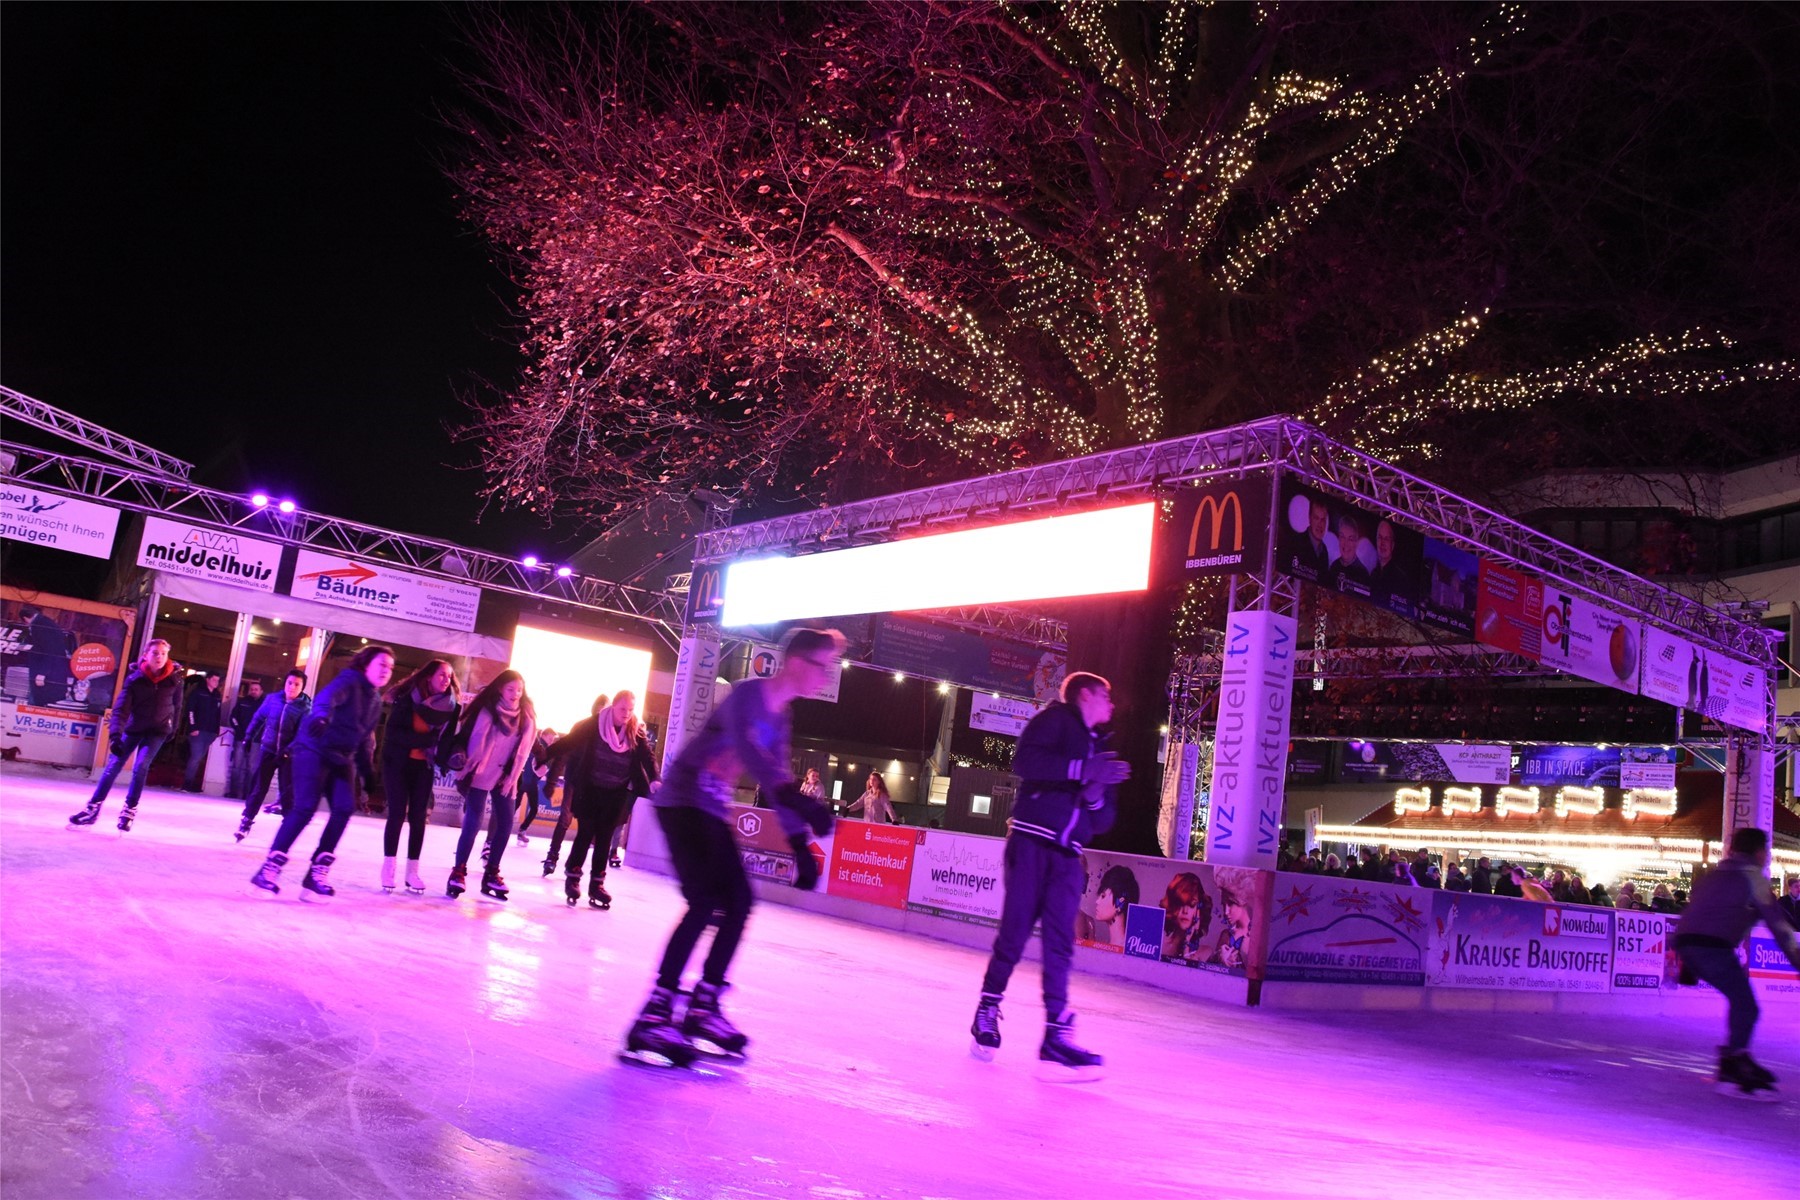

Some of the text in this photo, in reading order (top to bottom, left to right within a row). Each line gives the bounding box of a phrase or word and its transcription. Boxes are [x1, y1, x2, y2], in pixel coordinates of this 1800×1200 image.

[17, 513, 68, 532] wünscht
[72, 524, 105, 540] Ihnen
[183, 528, 239, 555] AVM
[146, 542, 272, 581] middelhuis
[1185, 554, 1242, 569] IBBENBÜREN
[317, 574, 400, 605] Bäumer
[893, 623, 905, 633] sind
[15, 715, 68, 731] VR-Bank
[1525, 759, 1541, 774] IBB
[1544, 760, 1554, 775] IN
[1556, 760, 1586, 776] SPACE
[841, 847, 908, 871] Immobilienkauf
[838, 866, 884, 889] ist einfach.
[931, 866, 997, 893] wehmeyer
[935, 884, 973, 899] Immobilien
[1617, 917, 1663, 936] RADIO
[1127, 935, 1159, 956] Plaar
[1455, 933, 1609, 974] KRAUSE BAUSTOFFE
[1617, 936, 1644, 953] RST
[1271, 949, 1419, 971] AUTOMOBILE STIEGEMEYER
[1616, 975, 1658, 987] 100% VON HIER
